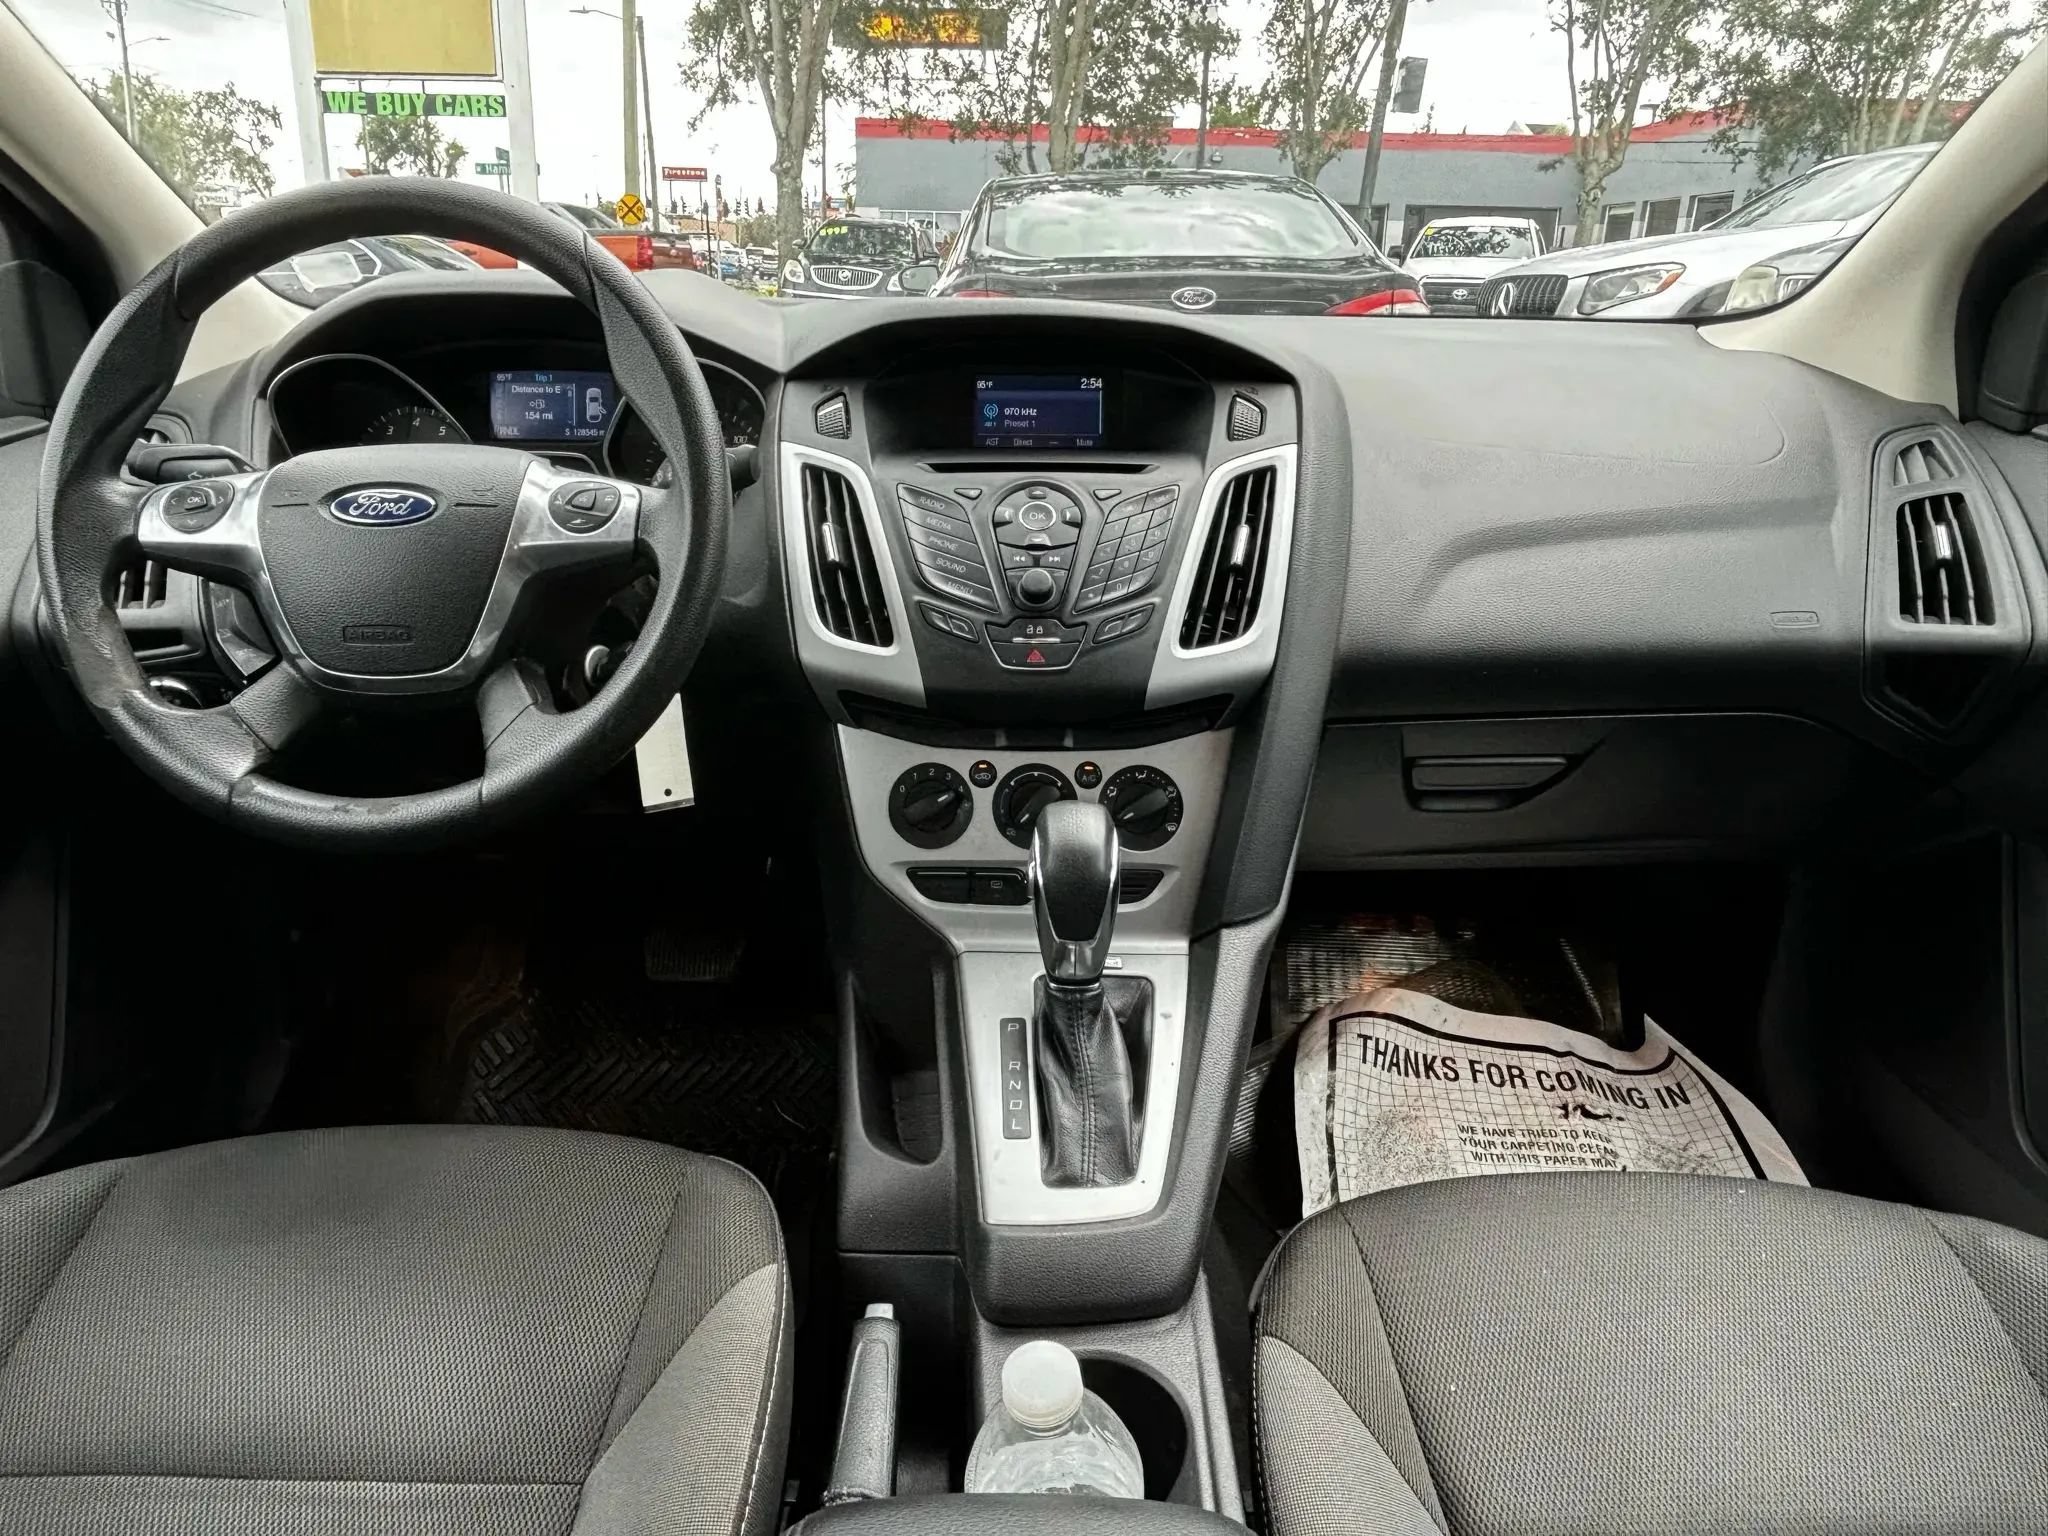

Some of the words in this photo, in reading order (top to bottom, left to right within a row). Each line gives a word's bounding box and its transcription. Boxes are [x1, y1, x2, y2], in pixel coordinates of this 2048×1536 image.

[326, 92, 367, 114] WE
[375, 93, 427, 116] BUY
[436, 94, 504, 117] CARS
[1181, 290, 1207, 303] Ford
[1080, 378, 1102, 389] 2:54
[511, 385, 544, 394] Distance
[545, 385, 554, 394] to
[525, 411, 540, 420] 154
[542, 411, 553, 420] mi
[1021, 407, 1037, 416] kHz
[412, 417, 420, 427] 4
[1004, 420, 1029, 428] Preset
[386, 425, 394, 435] 3
[438, 426, 447, 435] 5
[347, 491, 416, 517] Ford
[920, 496, 945, 510] RADIO
[1029, 511, 1046, 520] OK
[926, 516, 952, 530] MEDIA
[928, 535, 958, 551] PHONE
[936, 557, 967, 573] SOUND
[947, 581, 974, 595] MENU
[929, 768, 935, 776] 2
[946, 772, 952, 780] 3
[899, 785, 906, 793] 0
[958, 785, 964, 793] 4
[1007, 1023, 1020, 1032] P
[1008, 1061, 1021, 1070] R
[1357, 1033, 1460, 1083] THANKS
[1468, 1058, 1529, 1090] FOR
[1535, 1068, 1650, 1110] COMING
[1654, 1082, 1691, 1110] IN
[1009, 1080, 1022, 1090] N
[1009, 1100, 1023, 1110] D
[1011, 1118, 1023, 1130] L
[1457, 1124, 1478, 1136] WE
[1482, 1126, 1516, 1138] HAVE
[1519, 1128, 1558, 1139] TRIED
[1560, 1129, 1579, 1140] TO
[1583, 1129, 1613, 1145] KEEP
[1458, 1137, 1498, 1150] YOUR
[1500, 1140, 1576, 1154] CARPETING
[1469, 1151, 1506, 1164] WITH
[1508, 1152, 1541, 1164] THIS
[1544, 1156, 1588, 1167] PAPER
[1590, 1157, 1619, 1169] MAT
